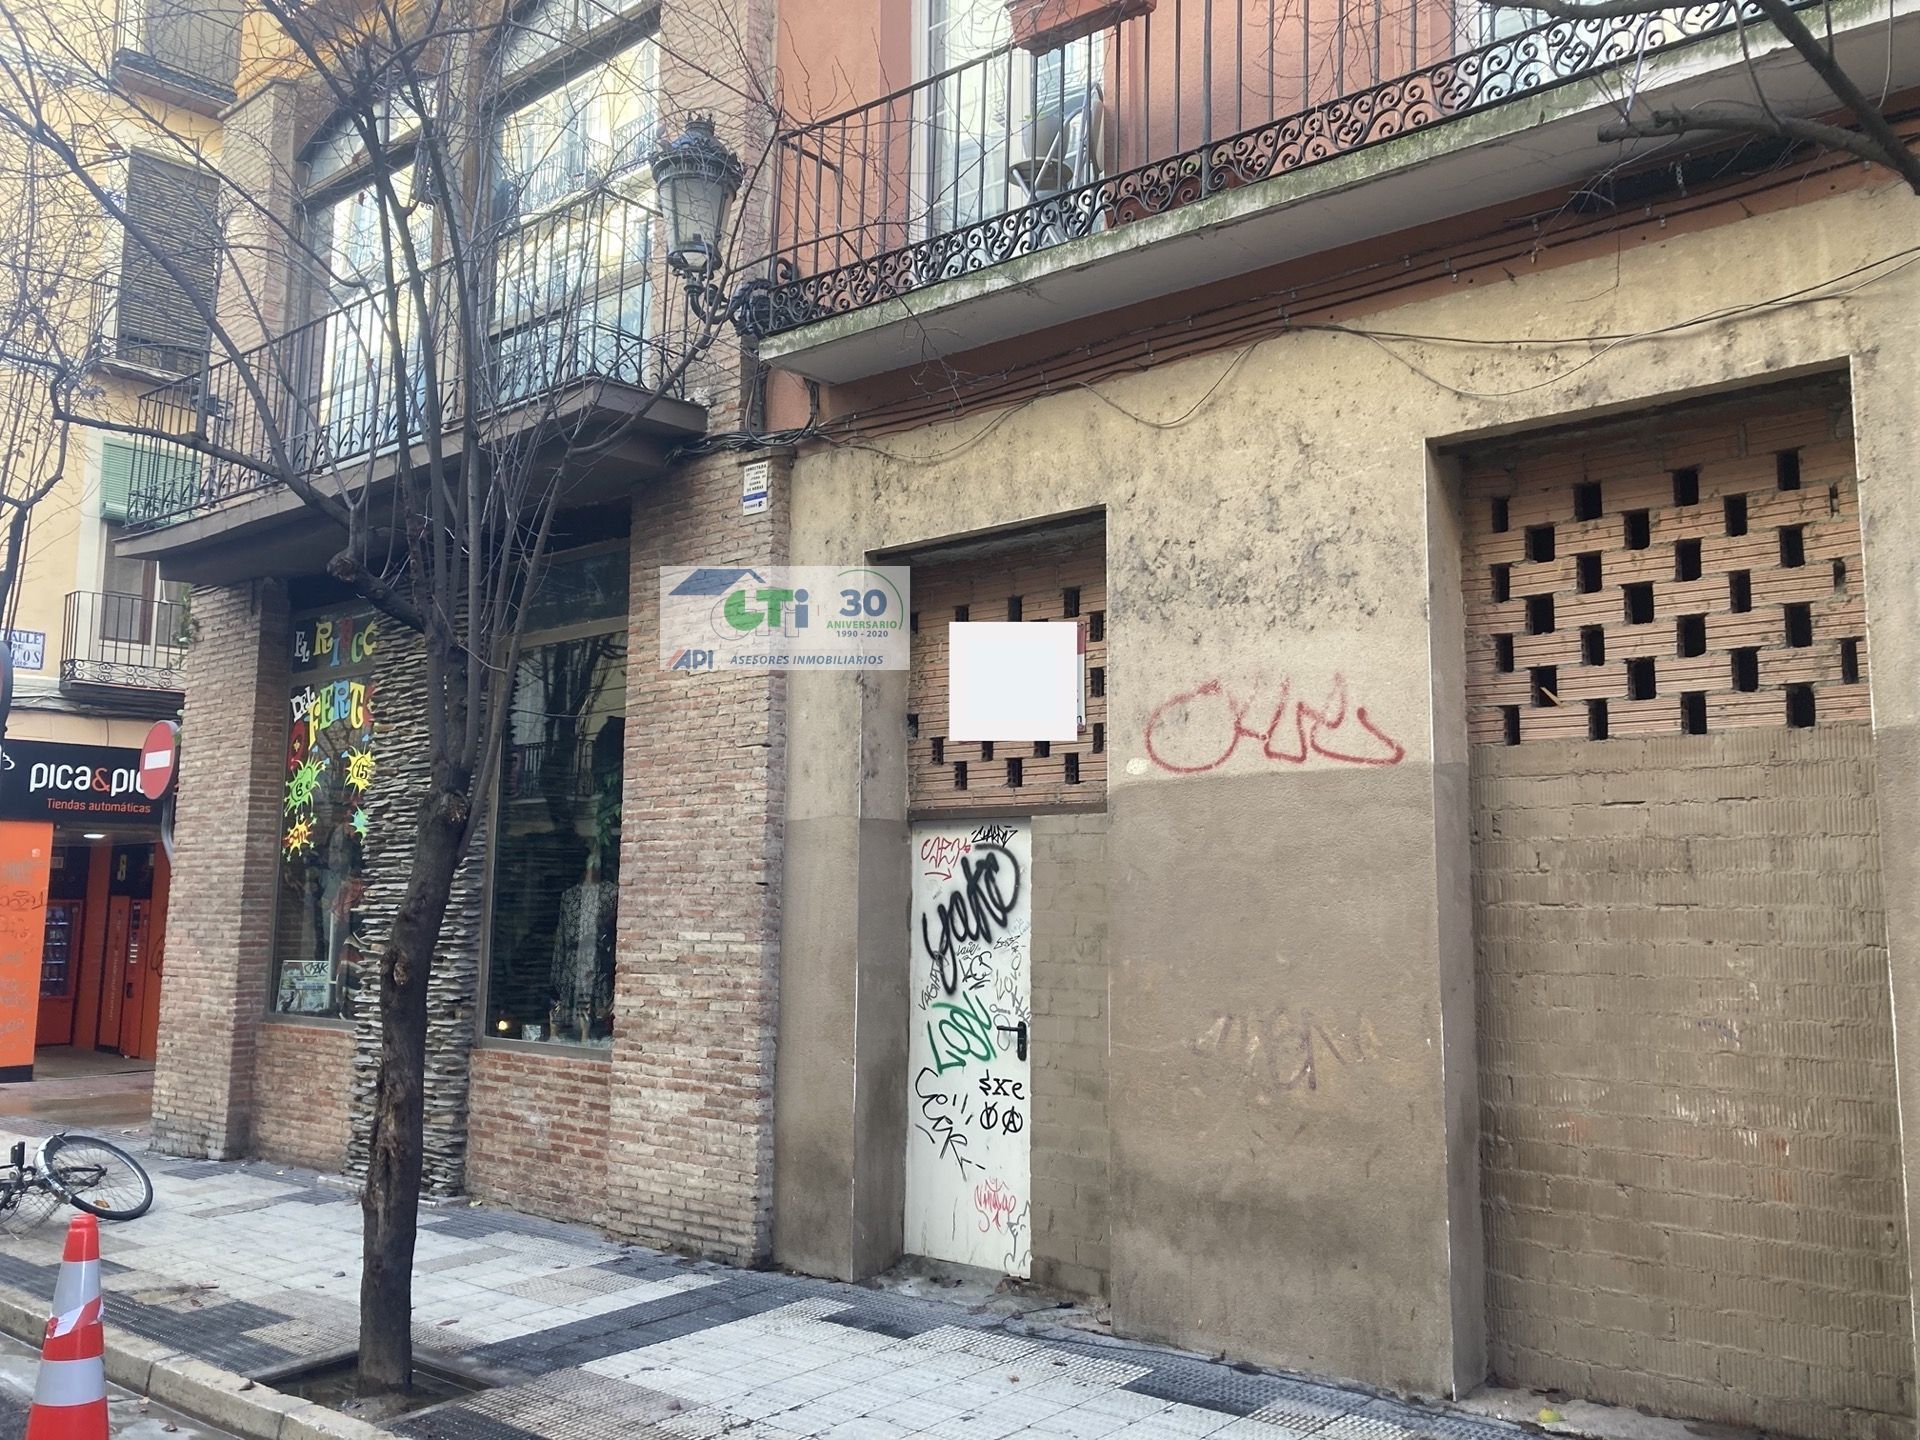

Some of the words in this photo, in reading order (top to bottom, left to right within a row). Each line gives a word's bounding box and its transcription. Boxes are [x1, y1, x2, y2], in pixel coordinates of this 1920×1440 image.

[12, 632, 41, 645] ALLE
[47, 797, 87, 811] Tiendas
[88, 800, 151, 814] automáticas
